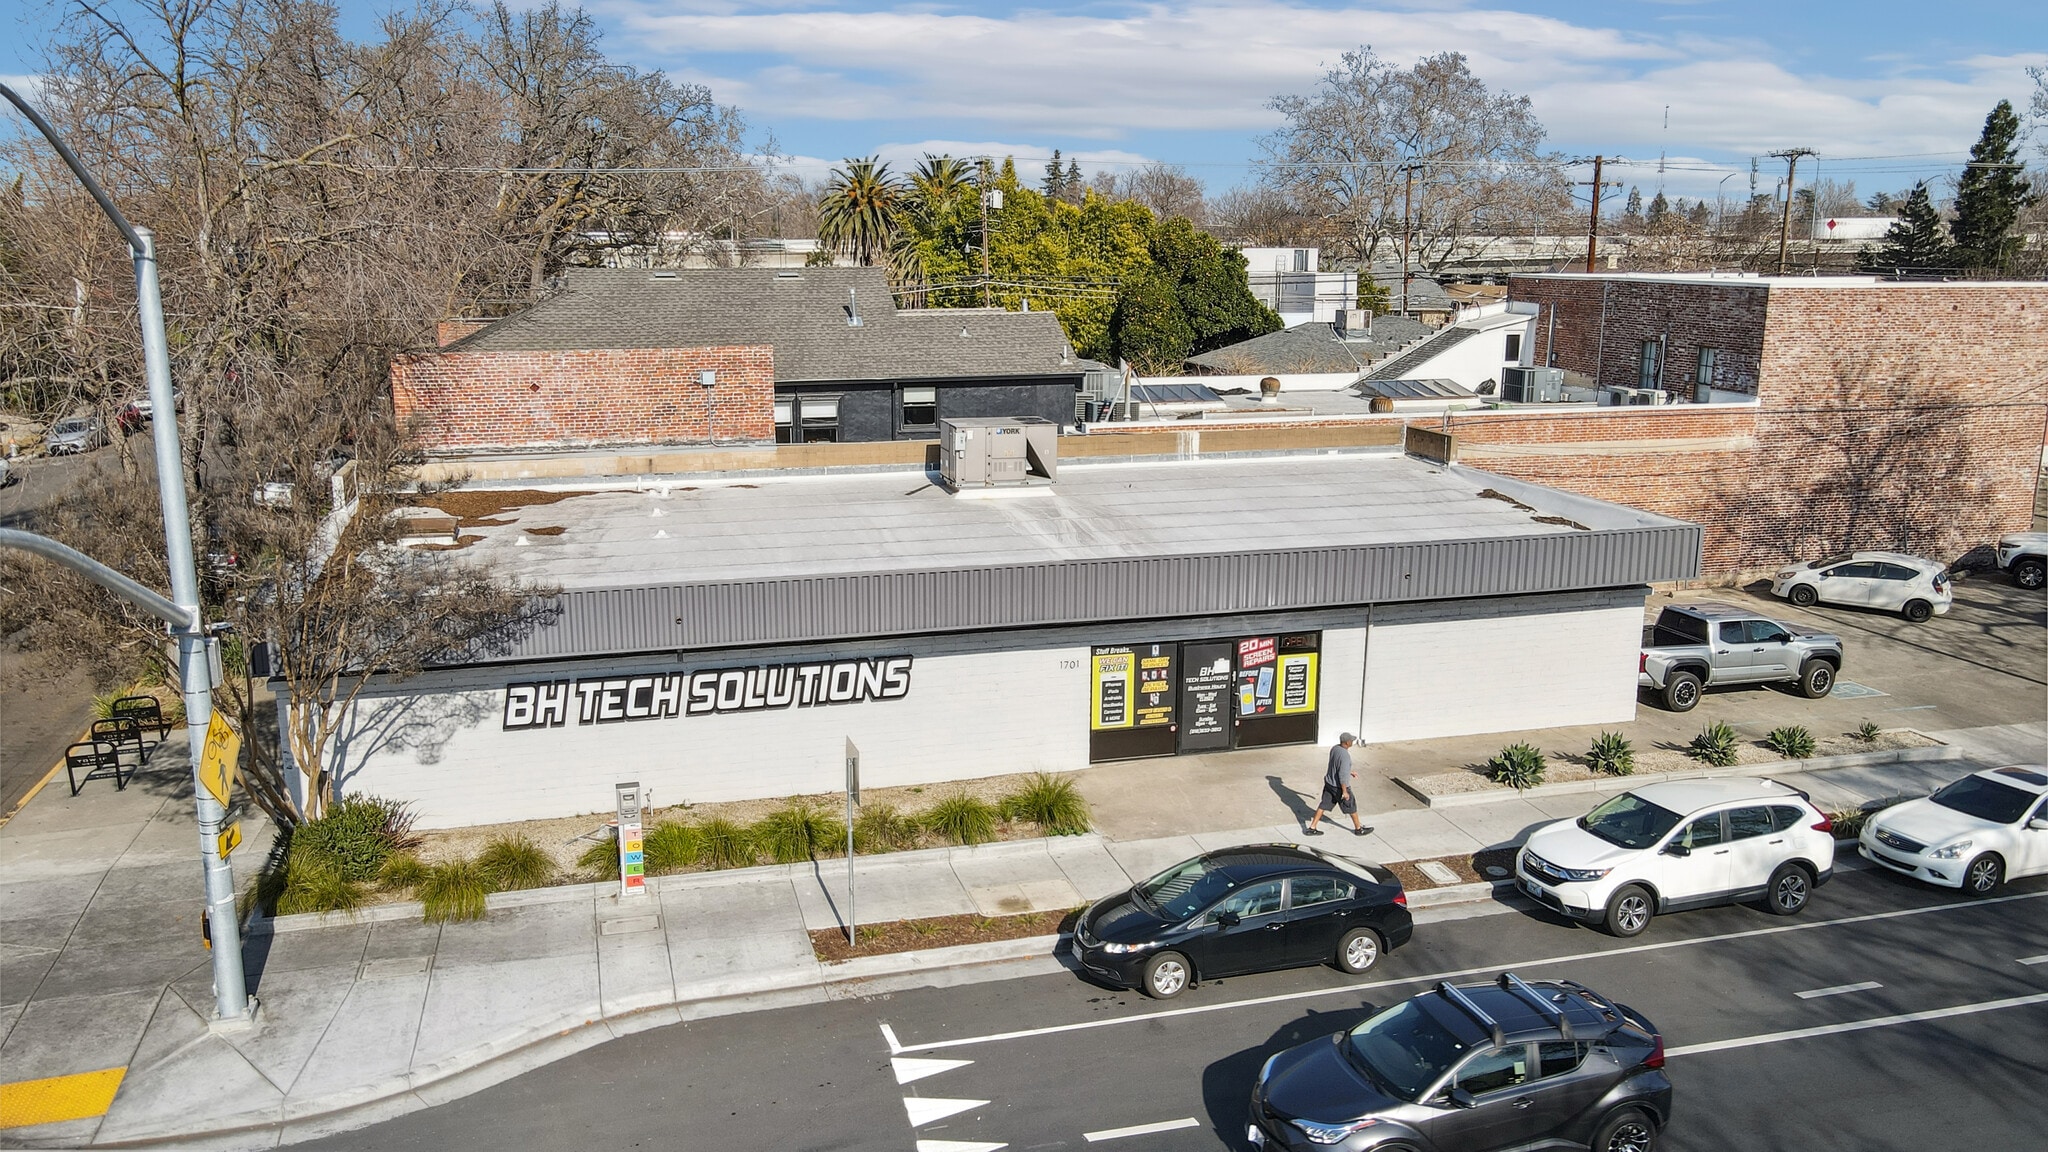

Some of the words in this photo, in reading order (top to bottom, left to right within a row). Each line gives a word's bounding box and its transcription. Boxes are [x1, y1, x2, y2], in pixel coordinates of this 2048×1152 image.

[1239, 639, 1259, 654] 20
[1259, 638, 1274, 649] MIN
[1284, 636, 1309, 647] OPEN
[1243, 647, 1274, 661] SCREEN
[1060, 660, 1079, 669] 1701
[1243, 652, 1276, 668] REPAIRS
[1099, 664, 1115, 672] FIX
[1116, 663, 1128, 671] IT!
[1199, 667, 1215, 676] BH
[1239, 670, 1259, 678] BEFORE
[1199, 675, 1229, 683] SOLUTIONS
[503, 679, 570, 731] BH
[575, 671, 684, 726] TECH
[686, 654, 914, 717] SOLUTIONS
[1256, 698, 1272, 706] AFTER
